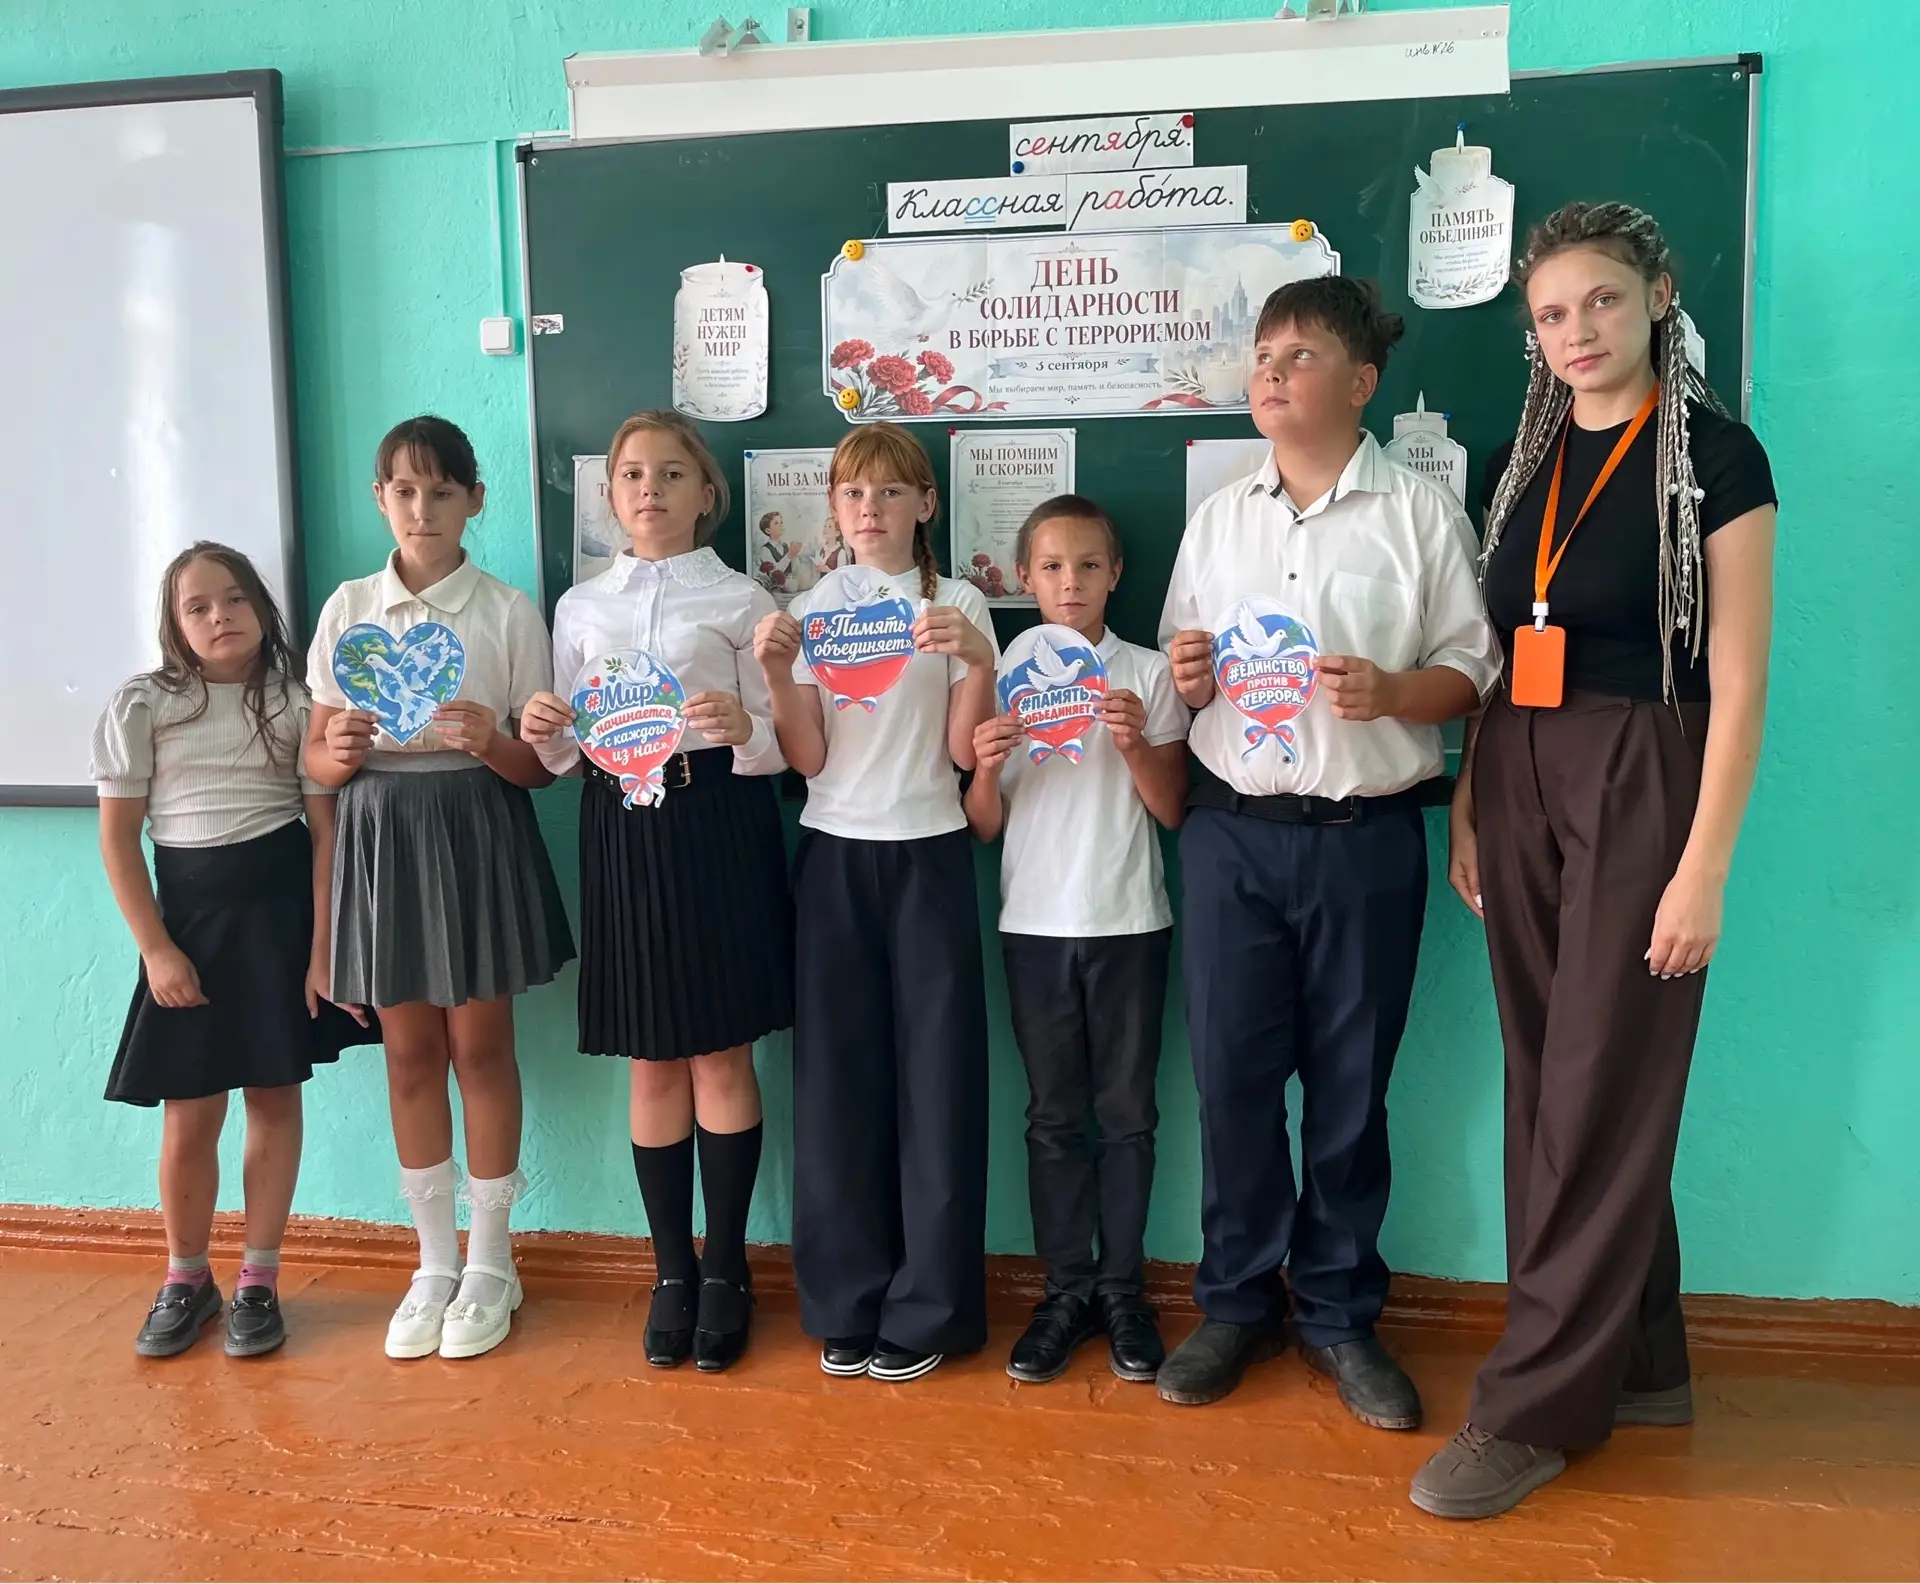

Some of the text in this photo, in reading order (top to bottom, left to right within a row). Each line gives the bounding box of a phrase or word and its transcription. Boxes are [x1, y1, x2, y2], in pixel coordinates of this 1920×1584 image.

[896, 188, 1063, 220] Классная
[1431, 208, 1494, 227] ПАМЯТЬ
[1419, 222, 1504, 244] ОБЪЕДИНЯЕТ
[1030, 257, 1119, 292] ДЕНЬ
[980, 289, 1179, 322] СОЛИДАРНОСТИ
[699, 308, 745, 324] ДЕТЯМ
[697, 325, 747, 340] НУЖЕН
[949, 321, 1211, 349] В БОРЬБЕ С ТЕРРОРИЗМОМ
[704, 341, 741, 357] МИР
[1048, 359, 1108, 373] сентября
[988, 385, 1003, 394] Мы
[970, 448, 1058, 461] МЫ ПОМНИМ
[1407, 447, 1434, 459] МЫ
[976, 463, 1055, 476] И СКОРБИМ
[1401, 460, 1454, 473] МНИМ
[766, 473, 790, 487] МЫ
[793, 472, 809, 486] ЗА
[1229, 659, 1306, 683] #ЕДИНСТВО
[1246, 676, 1289, 690] ПРОТИВ
[586, 681, 653, 716] #Мир
[1020, 687, 1090, 712] #ПАМЯТЬ
[1242, 689, 1306, 708] ТЕРРОРА.
[596, 708, 673, 736] начинается
[1025, 703, 1092, 725] ОБЪЕДИНЯЕТ
[604, 724, 667, 748] с каждого
[612, 748, 630, 766] из
